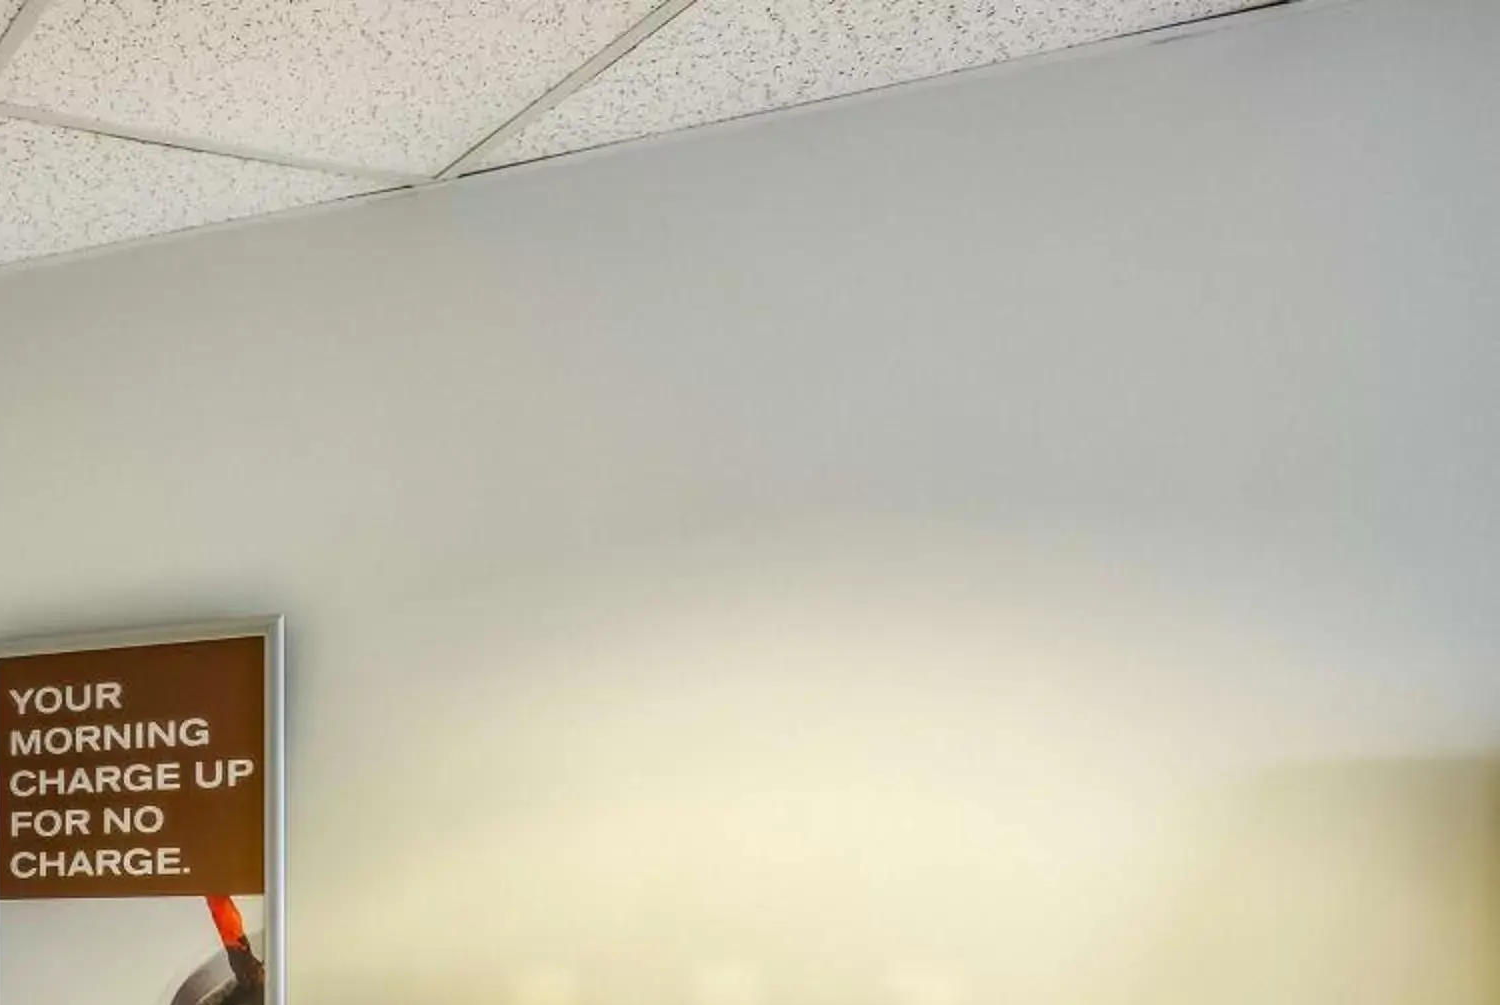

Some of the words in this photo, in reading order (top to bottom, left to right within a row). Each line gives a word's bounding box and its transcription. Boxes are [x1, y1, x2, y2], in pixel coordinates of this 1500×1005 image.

[8, 682, 123, 716] YOUR
[9, 717, 210, 757] MORNING
[9, 762, 181, 798] CHARGE
[194, 759, 254, 790] UP
[10, 808, 91, 838] FOR
[103, 804, 164, 835] NO
[9, 847, 192, 879] CHARGE.
